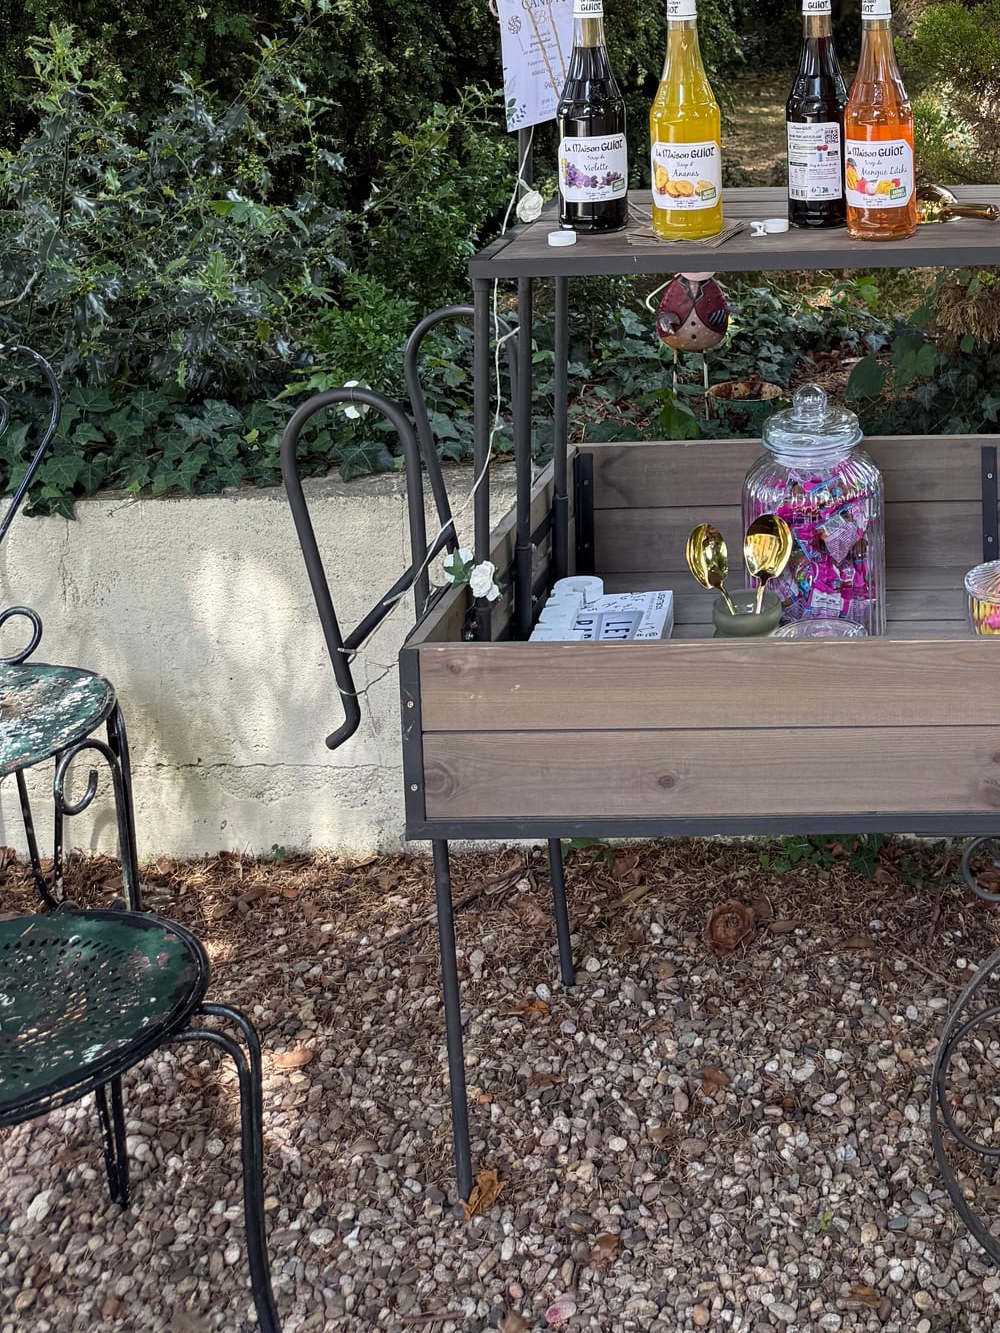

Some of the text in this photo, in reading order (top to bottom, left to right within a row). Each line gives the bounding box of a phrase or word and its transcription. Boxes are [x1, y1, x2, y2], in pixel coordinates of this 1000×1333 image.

[572, 143, 600, 153] Maison
[852, 147, 877, 157] Maison
[662, 149, 690, 159] Maison
